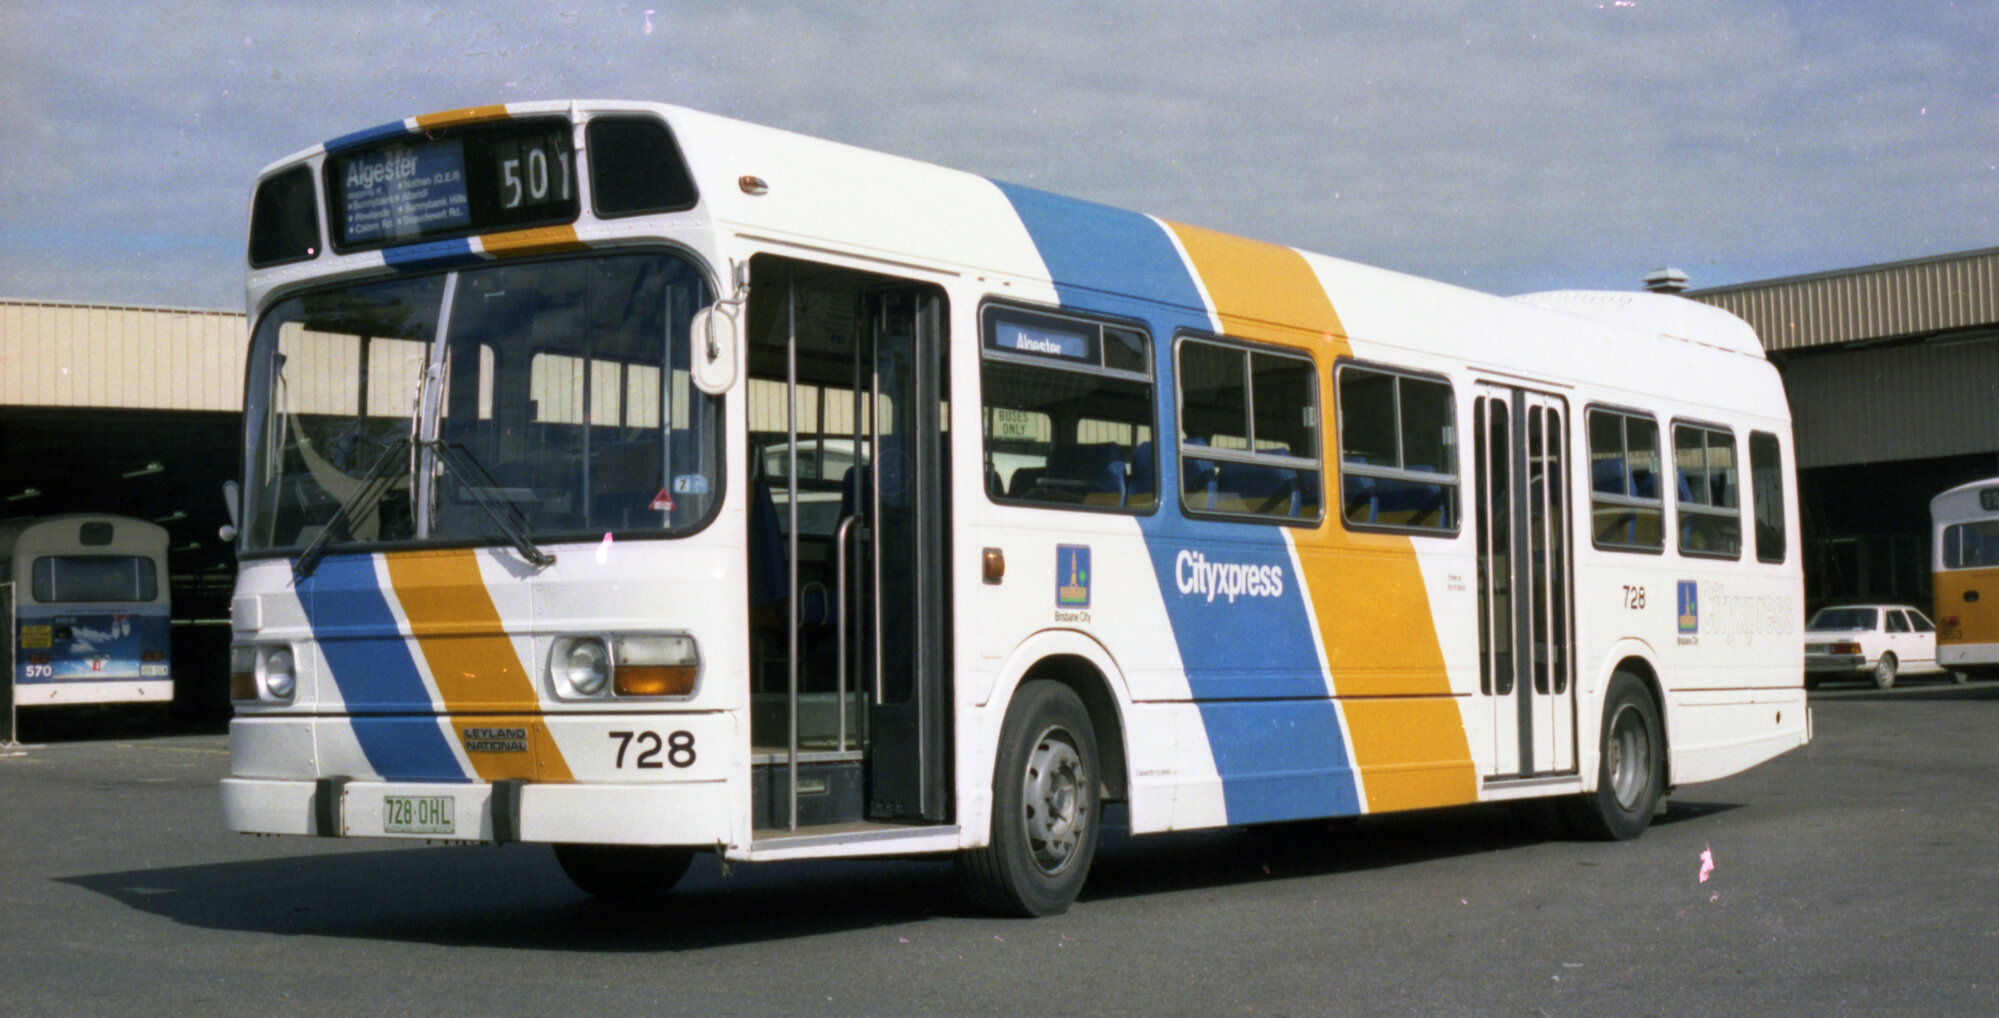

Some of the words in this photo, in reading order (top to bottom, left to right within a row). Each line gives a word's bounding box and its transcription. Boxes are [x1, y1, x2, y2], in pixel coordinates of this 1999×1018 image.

[346, 155, 419, 189] Algester
[503, 149, 570, 209] 501
[404, 196, 448, 213] Sunnybank
[999, 410, 1028, 423] BUSES
[1002, 423, 1026, 435] ONLY
[1175, 549, 1284, 604] Cityxpress
[1622, 585, 1647, 610] 728
[1700, 580, 1794, 645] Cityxpress
[25, 664, 52, 678] 570
[464, 728, 526, 739] LEYLAND
[465, 741, 527, 751] NATIONAL
[608, 731, 696, 769] 728
